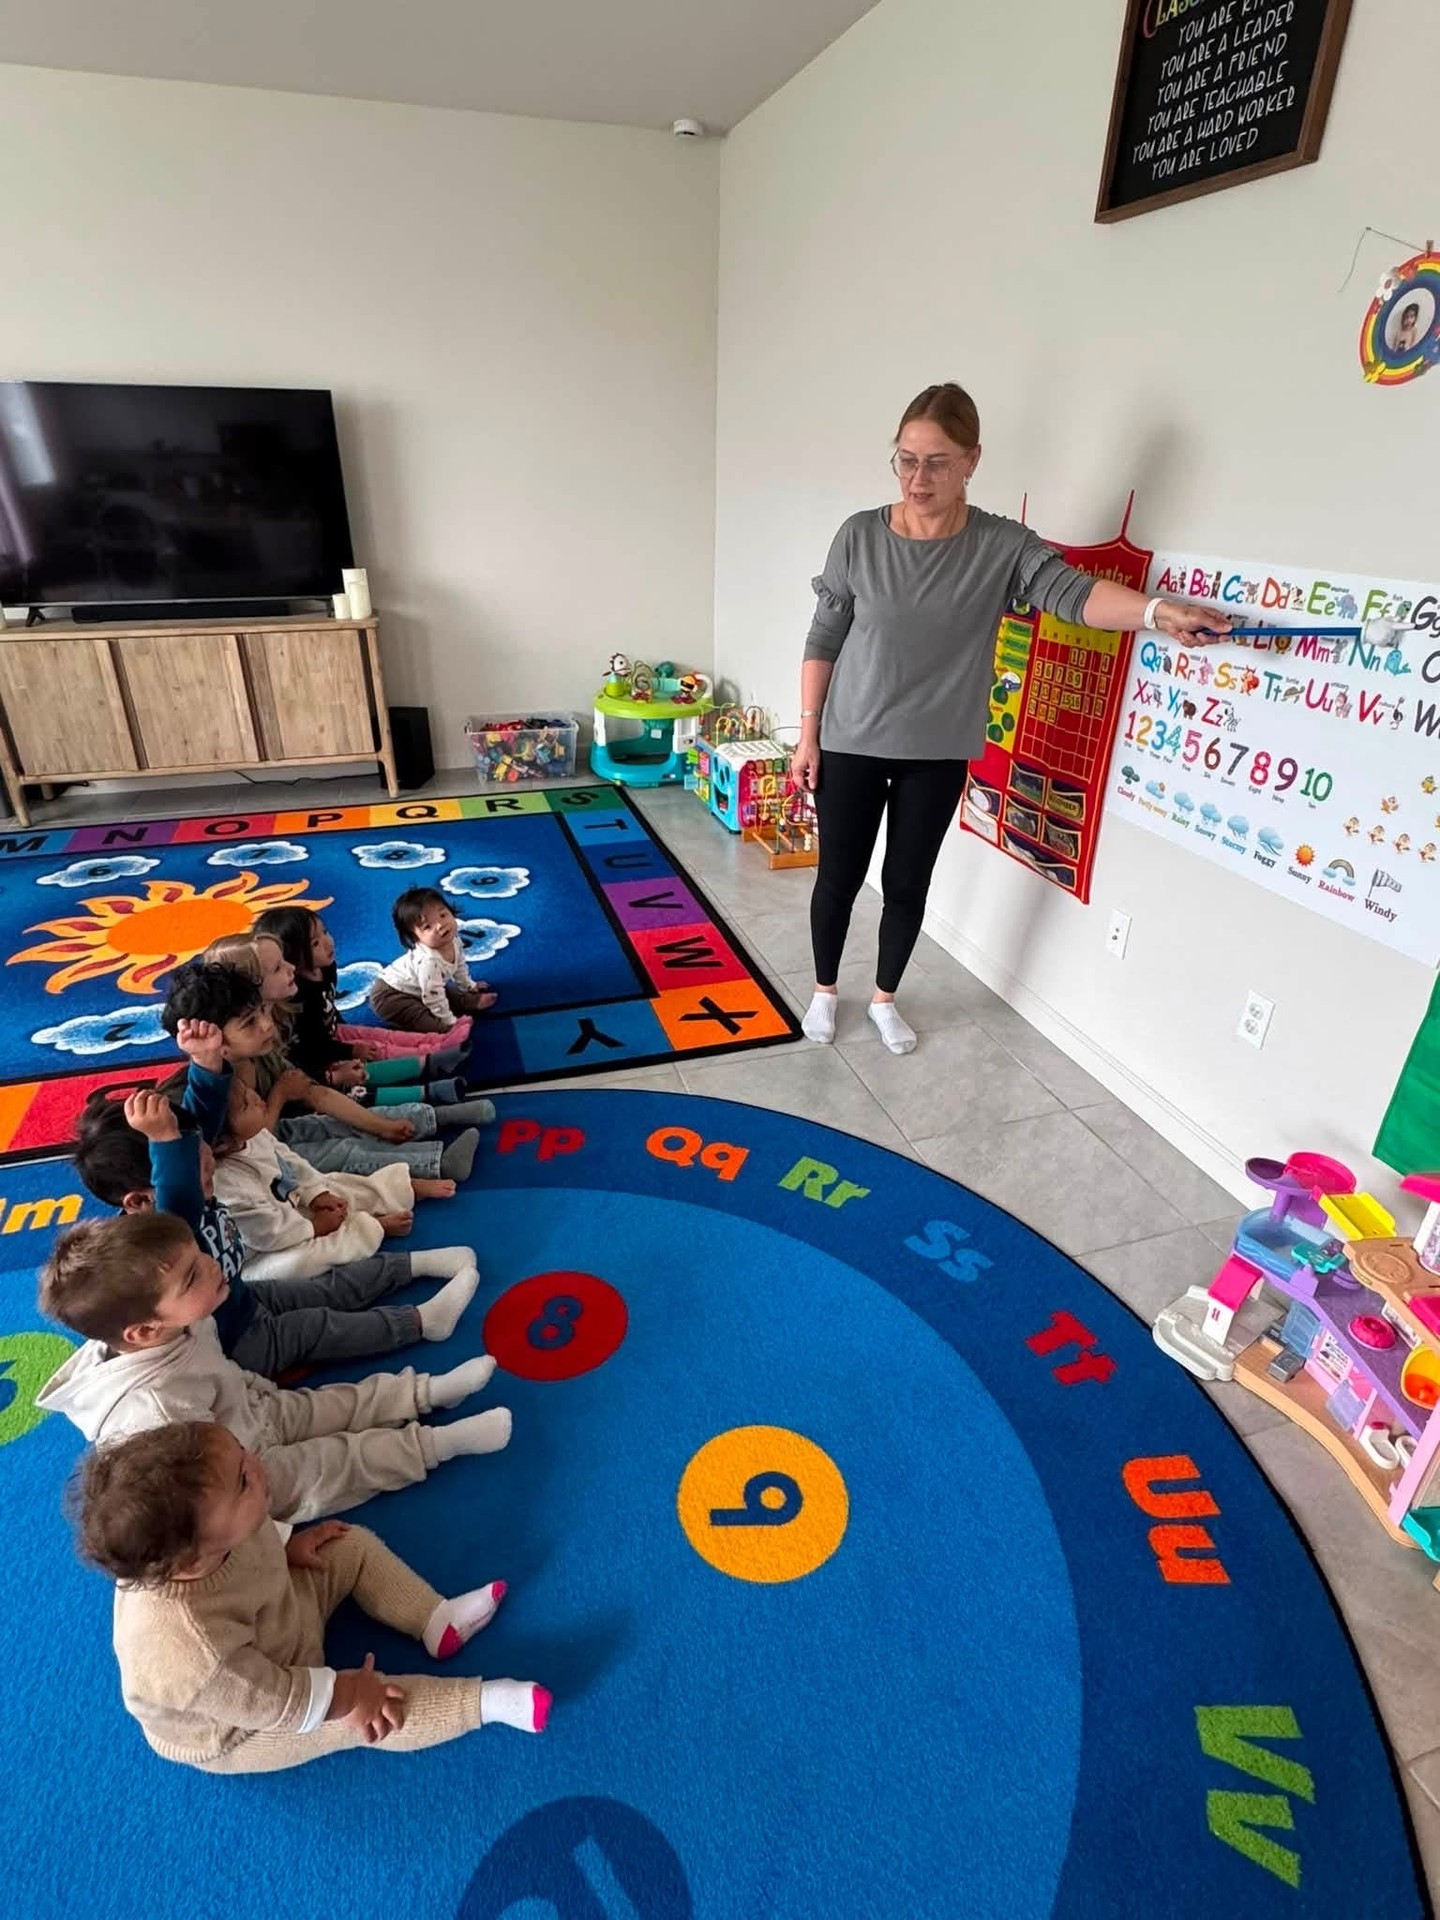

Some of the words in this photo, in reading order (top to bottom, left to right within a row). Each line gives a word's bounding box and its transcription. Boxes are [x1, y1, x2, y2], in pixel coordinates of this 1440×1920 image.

[1161, 53, 1186, 81] YOU
[1188, 38, 1215, 68] ARE
[1217, 33, 1227, 55] A
[1233, 0, 1295, 47] LEADER
[1179, 16, 1205, 47] YOU
[1207, 1, 1237, 33] ARE
[1158, 80, 1182, 106] YOU
[1184, 67, 1211, 96] ARE
[1213, 61, 1223, 83] A
[1228, 32, 1288, 76] FRIEND
[1148, 109, 1172, 135] YOU
[1173, 98, 1199, 125] ARE
[1202, 61, 1289, 113] TEACHABLE
[1132, 139, 1156, 165] YOU
[1157, 129, 1182, 155] ARE
[1183, 125, 1193, 146] A
[1197, 110, 1234, 141] HARD
[1237, 86, 1295, 125] WORKER
[1152, 156, 1176, 181] YOU
[1178, 146, 1206, 173] ARE
[1210, 128, 1259, 162] LOVED
[1156, 567, 1178, 593] Aa
[1189, 568, 1210, 597] Bb
[1222, 575, 1244, 603] Cc
[1261, 577, 1290, 609] Dd
[1307, 581, 1335, 615] Ee
[1133, 678, 1153, 705] Xx
[1167, 686, 1182, 718] Yy
[1201, 697, 1223, 727] Zz
[1140, 641, 1162, 673] Qq
[1174, 652, 1195, 680] Rr
[1214, 662, 1238, 690] Ss
[1264, 671, 1283, 702] Tt
[1305, 678, 1333, 713] Uu
[1359, 690, 1385, 725] Vv
[1125, 710, 1136, 741] 1
[1136, 715, 1152, 746] 2
[1151, 720, 1167, 750] 3
[1165, 725, 1182, 757] 4
[1183, 730, 1203, 763] 5
[1204, 737, 1221, 770] 6
[1227, 742, 1249, 776] 7
[1250, 751, 1271, 786] 8
[1274, 758, 1298, 791] 9
[1300, 768, 1333, 801] 10
[102, 827, 148, 845] N
[204, 820, 250, 835] O
[307, 813, 343, 827] P
[396, 805, 439, 819] Q
[486, 798, 524, 812] R
[561, 791, 599, 805] S
[584, 818, 628, 831] T
[88, 864, 111, 877] 6
[384, 849, 409, 861] 8
[603, 853, 653, 868] U
[628, 891, 684, 909] V
[1253, 850, 1277, 868] Foggy
[1287, 866, 1312, 885] Sunny
[1317, 880, 1355, 903] Rainbow
[1365, 898, 1397, 923] Windy
[654, 936, 724, 969] W
[566, 1018, 626, 1056] Y
[678, 996, 759, 1035] X
[526, 1295, 583, 1351] 8
[0, 1194, 83, 1235] m
[496, 1119, 586, 1162] Pp
[645, 1126, 750, 1181] Qq
[777, 1155, 871, 1209] Rr
[903, 1220, 995, 1283] Ss
[1024, 1309, 1119, 1386] Tt
[1121, 1454, 1231, 1585] Uu
[1193, 1705, 1316, 1889] Vv
